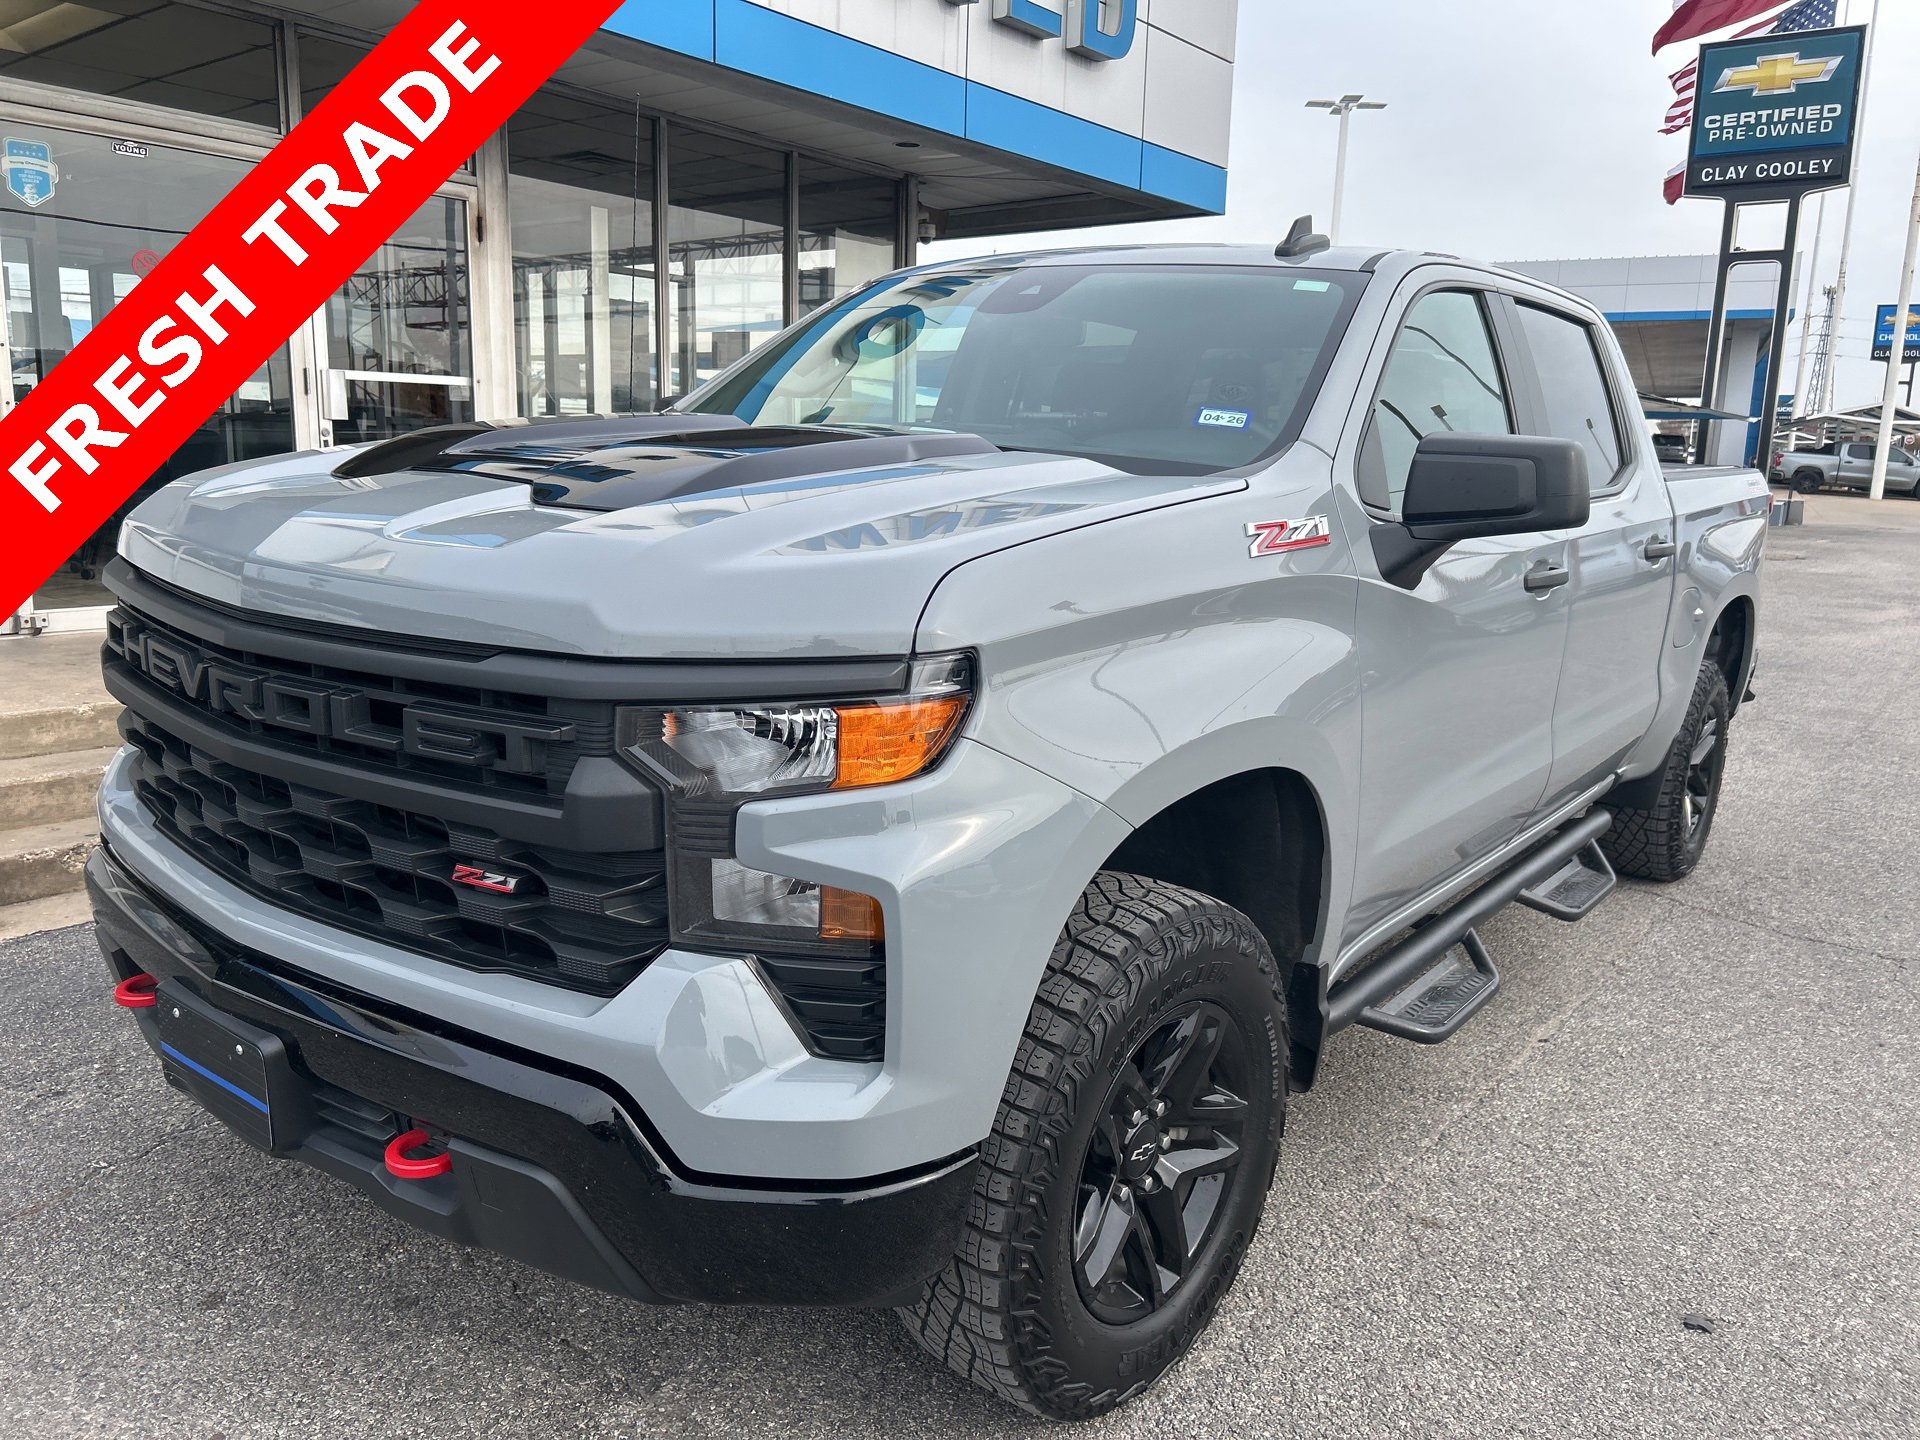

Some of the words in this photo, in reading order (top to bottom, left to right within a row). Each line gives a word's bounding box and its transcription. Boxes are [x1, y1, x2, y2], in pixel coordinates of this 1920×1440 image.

[1704, 103, 1842, 129] CERTIFIED
[1708, 119, 1833, 143] PRE-OWNED
[114, 143, 146, 155] YOUNG
[1701, 165, 1748, 182] CLAY
[1755, 158, 1833, 178] COOLEY
[1226, 415, 1245, 424] 26
[1243, 514, 1331, 558] Z71
[106, 605, 576, 775] CHEVROLET
[452, 863, 518, 893] Z71
